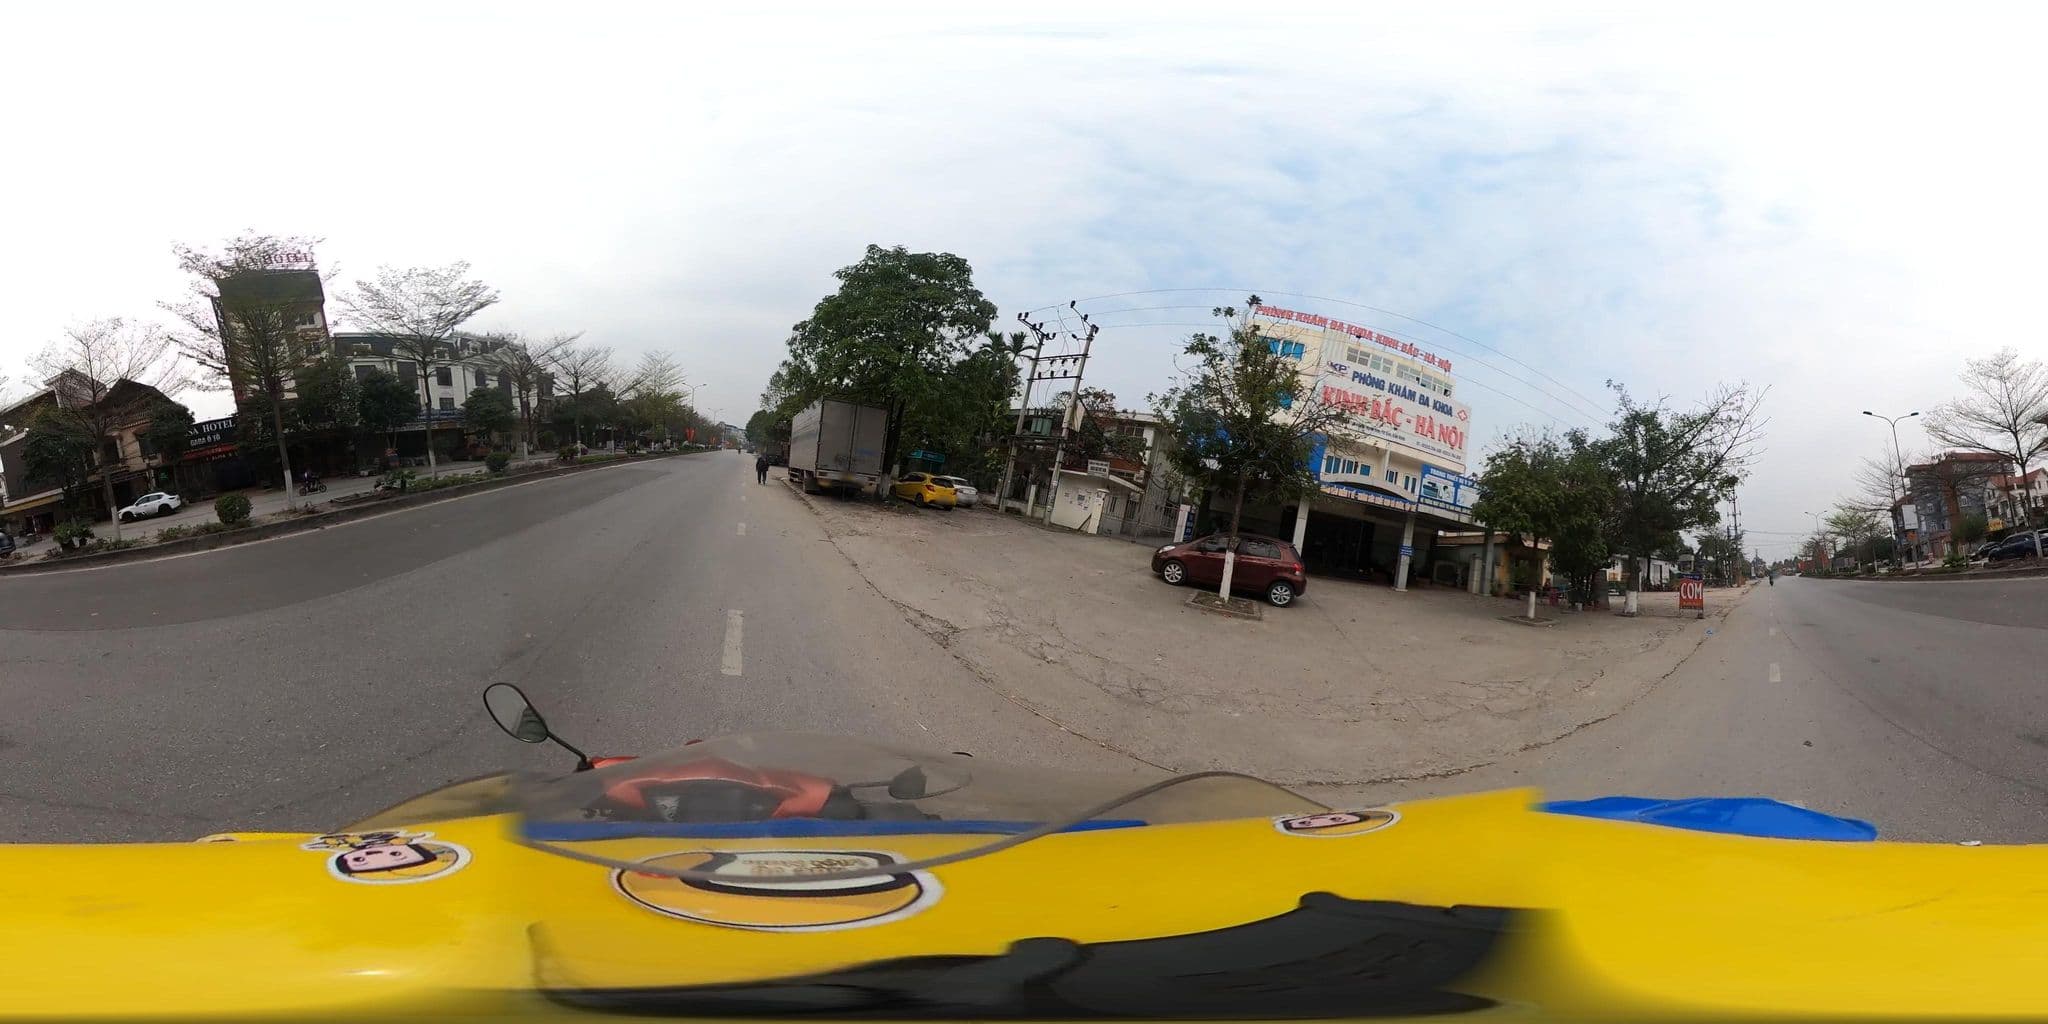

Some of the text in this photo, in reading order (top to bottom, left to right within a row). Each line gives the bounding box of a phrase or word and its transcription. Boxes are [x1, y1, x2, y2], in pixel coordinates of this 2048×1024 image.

[1255, 305, 1293, 320] PHÒNG
[1296, 312, 1328, 328] KHÁM
[1346, 324, 1373, 341] KHOA
[1376, 333, 1398, 350] KINH
[1351, 370, 1385, 391] PHÒNG
[1387, 382, 1417, 402] KHÁM
[1432, 399, 1453, 417] KHOA
[202, 419, 235, 433] HOTEL
[1369, 397, 1403, 427] BẮC
[1414, 414, 1435, 441] HÀ
[1438, 423, 1464, 450] NỘI
